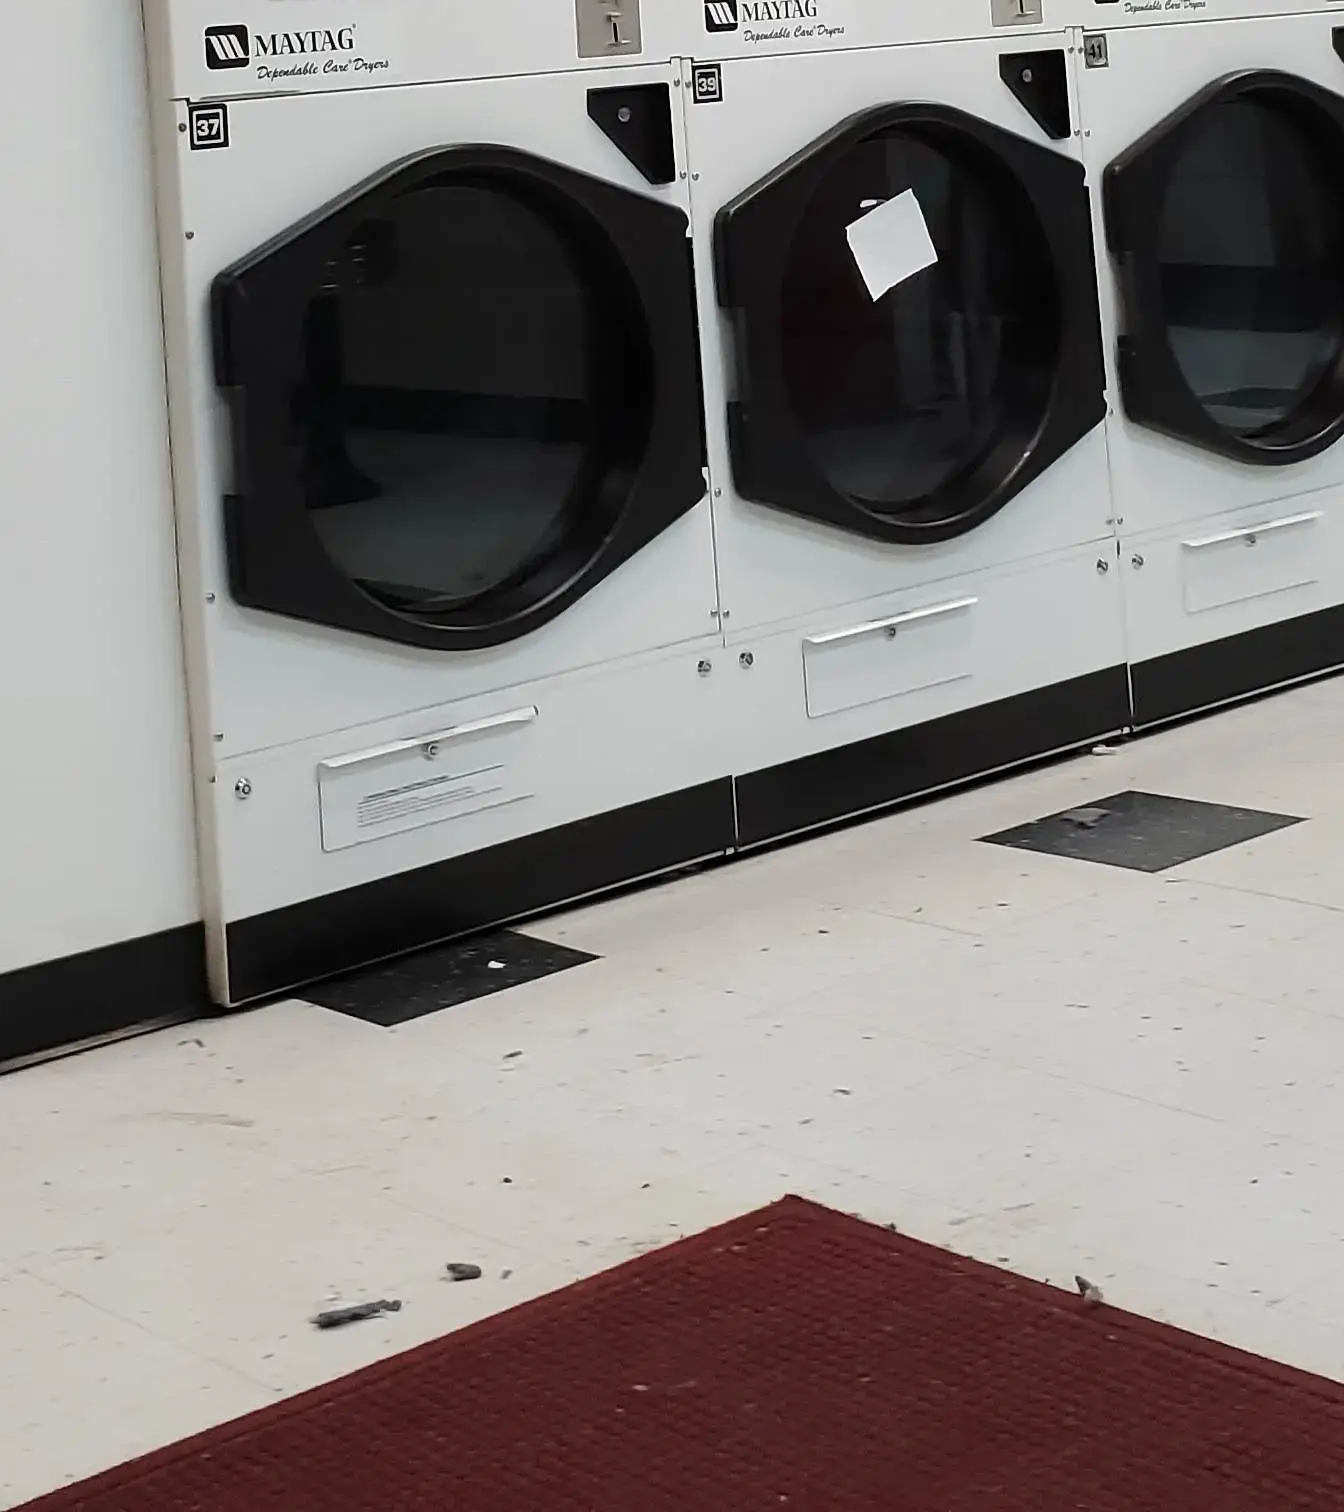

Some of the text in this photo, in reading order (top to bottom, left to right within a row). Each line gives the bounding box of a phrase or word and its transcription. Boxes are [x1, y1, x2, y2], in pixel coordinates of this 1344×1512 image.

[254, 27, 355, 57] MAYTAG
[743, 24, 845, 44] Dependable Care Dryers
[257, 57, 390, 82] Dependable Care Dryers
[698, 76, 717, 93] 39
[196, 118, 220, 137] 37
